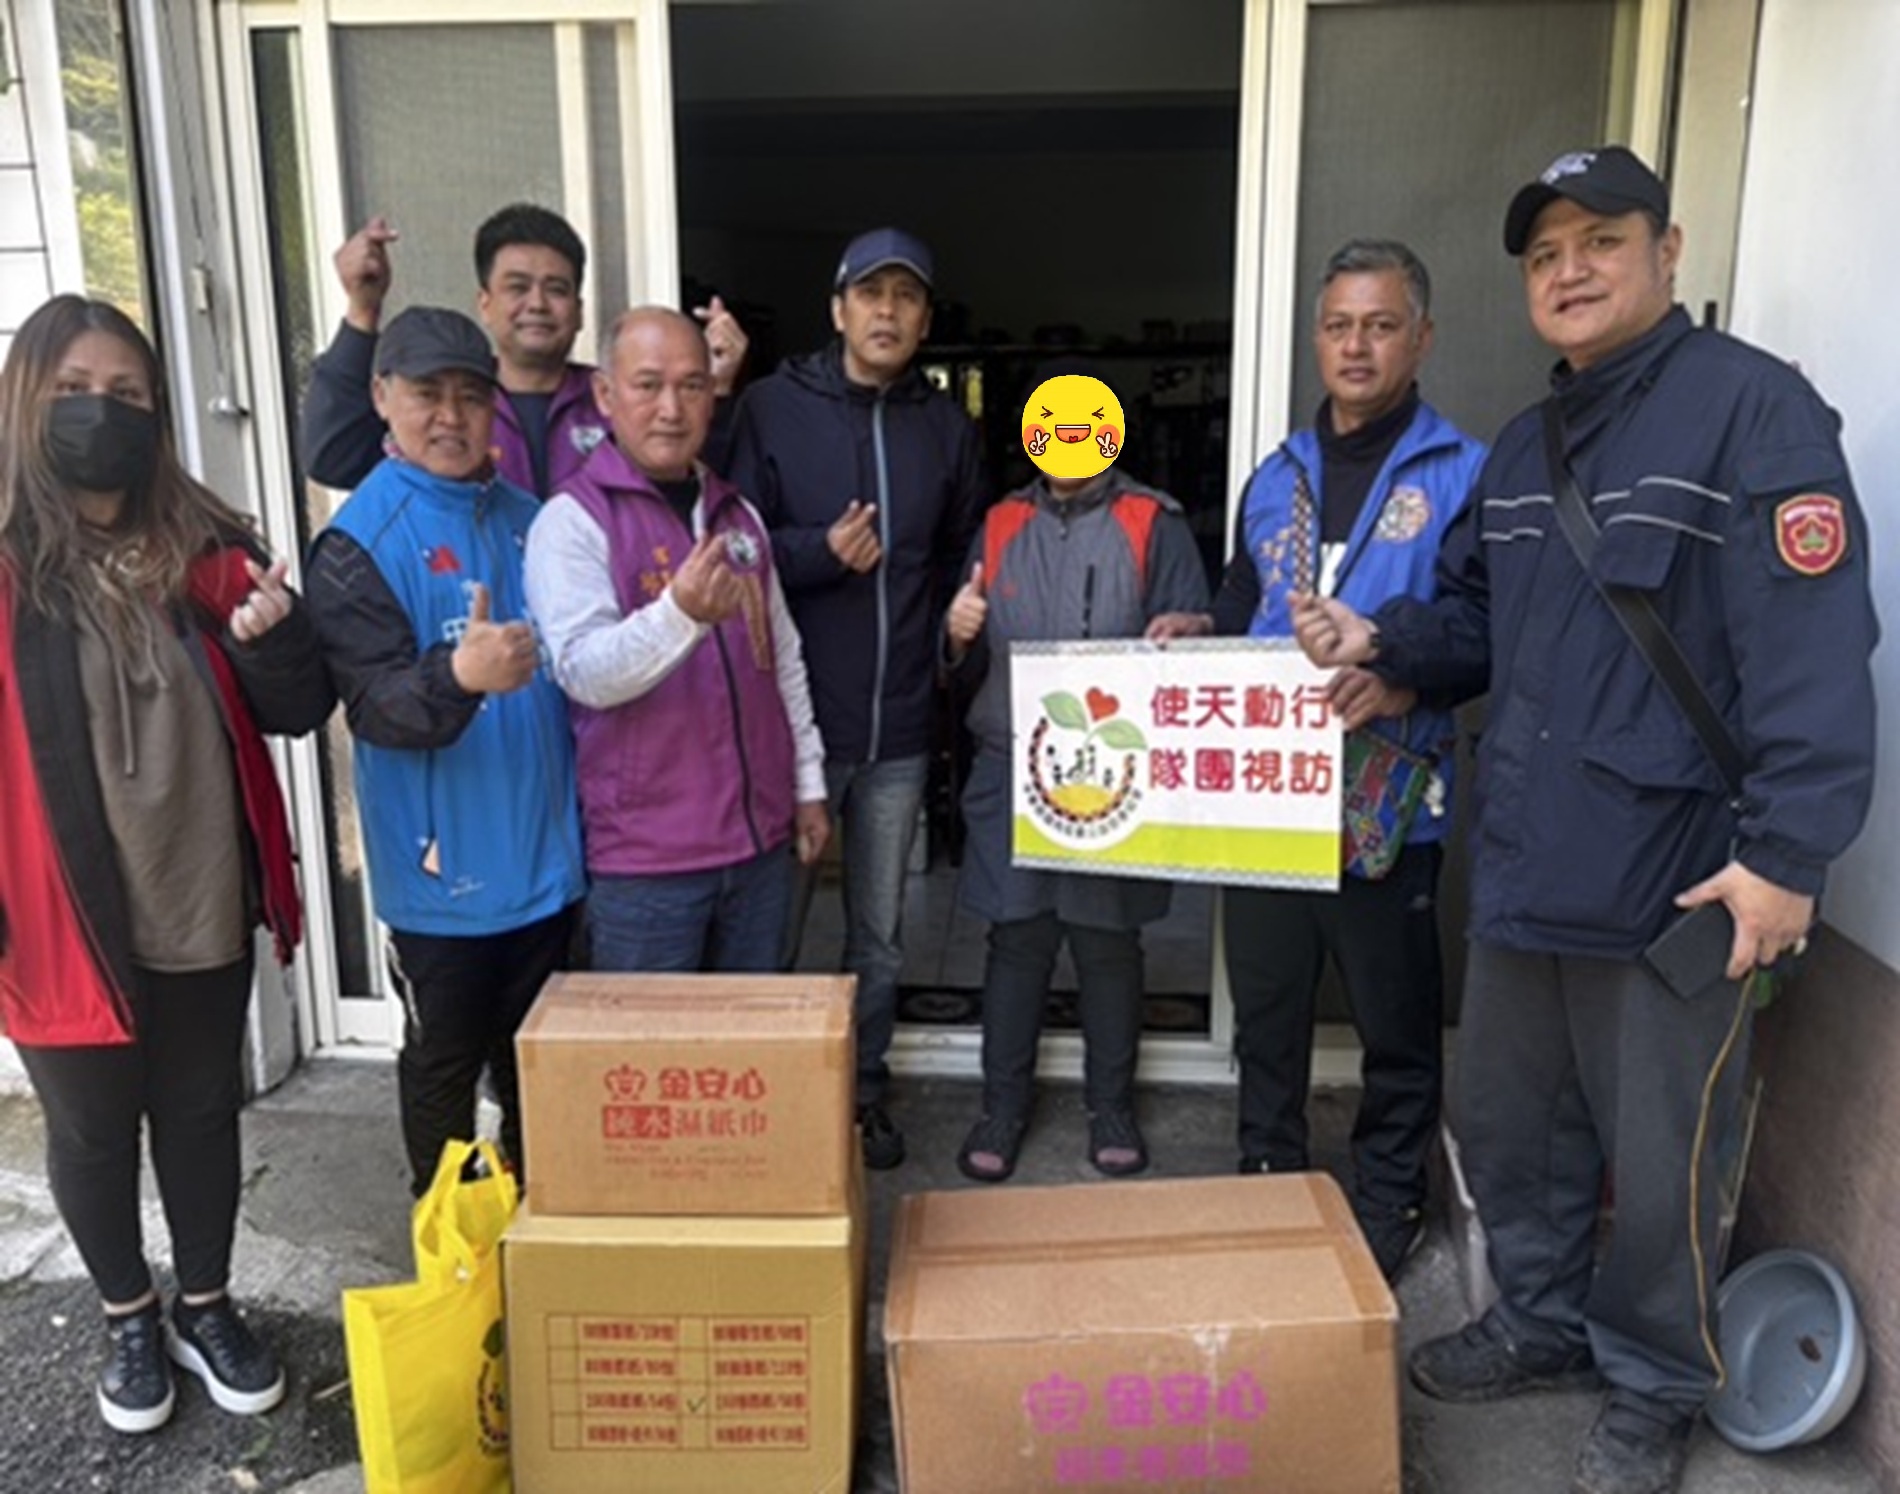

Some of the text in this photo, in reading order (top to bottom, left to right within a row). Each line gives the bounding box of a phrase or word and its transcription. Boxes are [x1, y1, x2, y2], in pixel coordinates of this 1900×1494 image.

[657, 1067, 767, 1101] 金安心
[1104, 1370, 1270, 1428] 金安心
